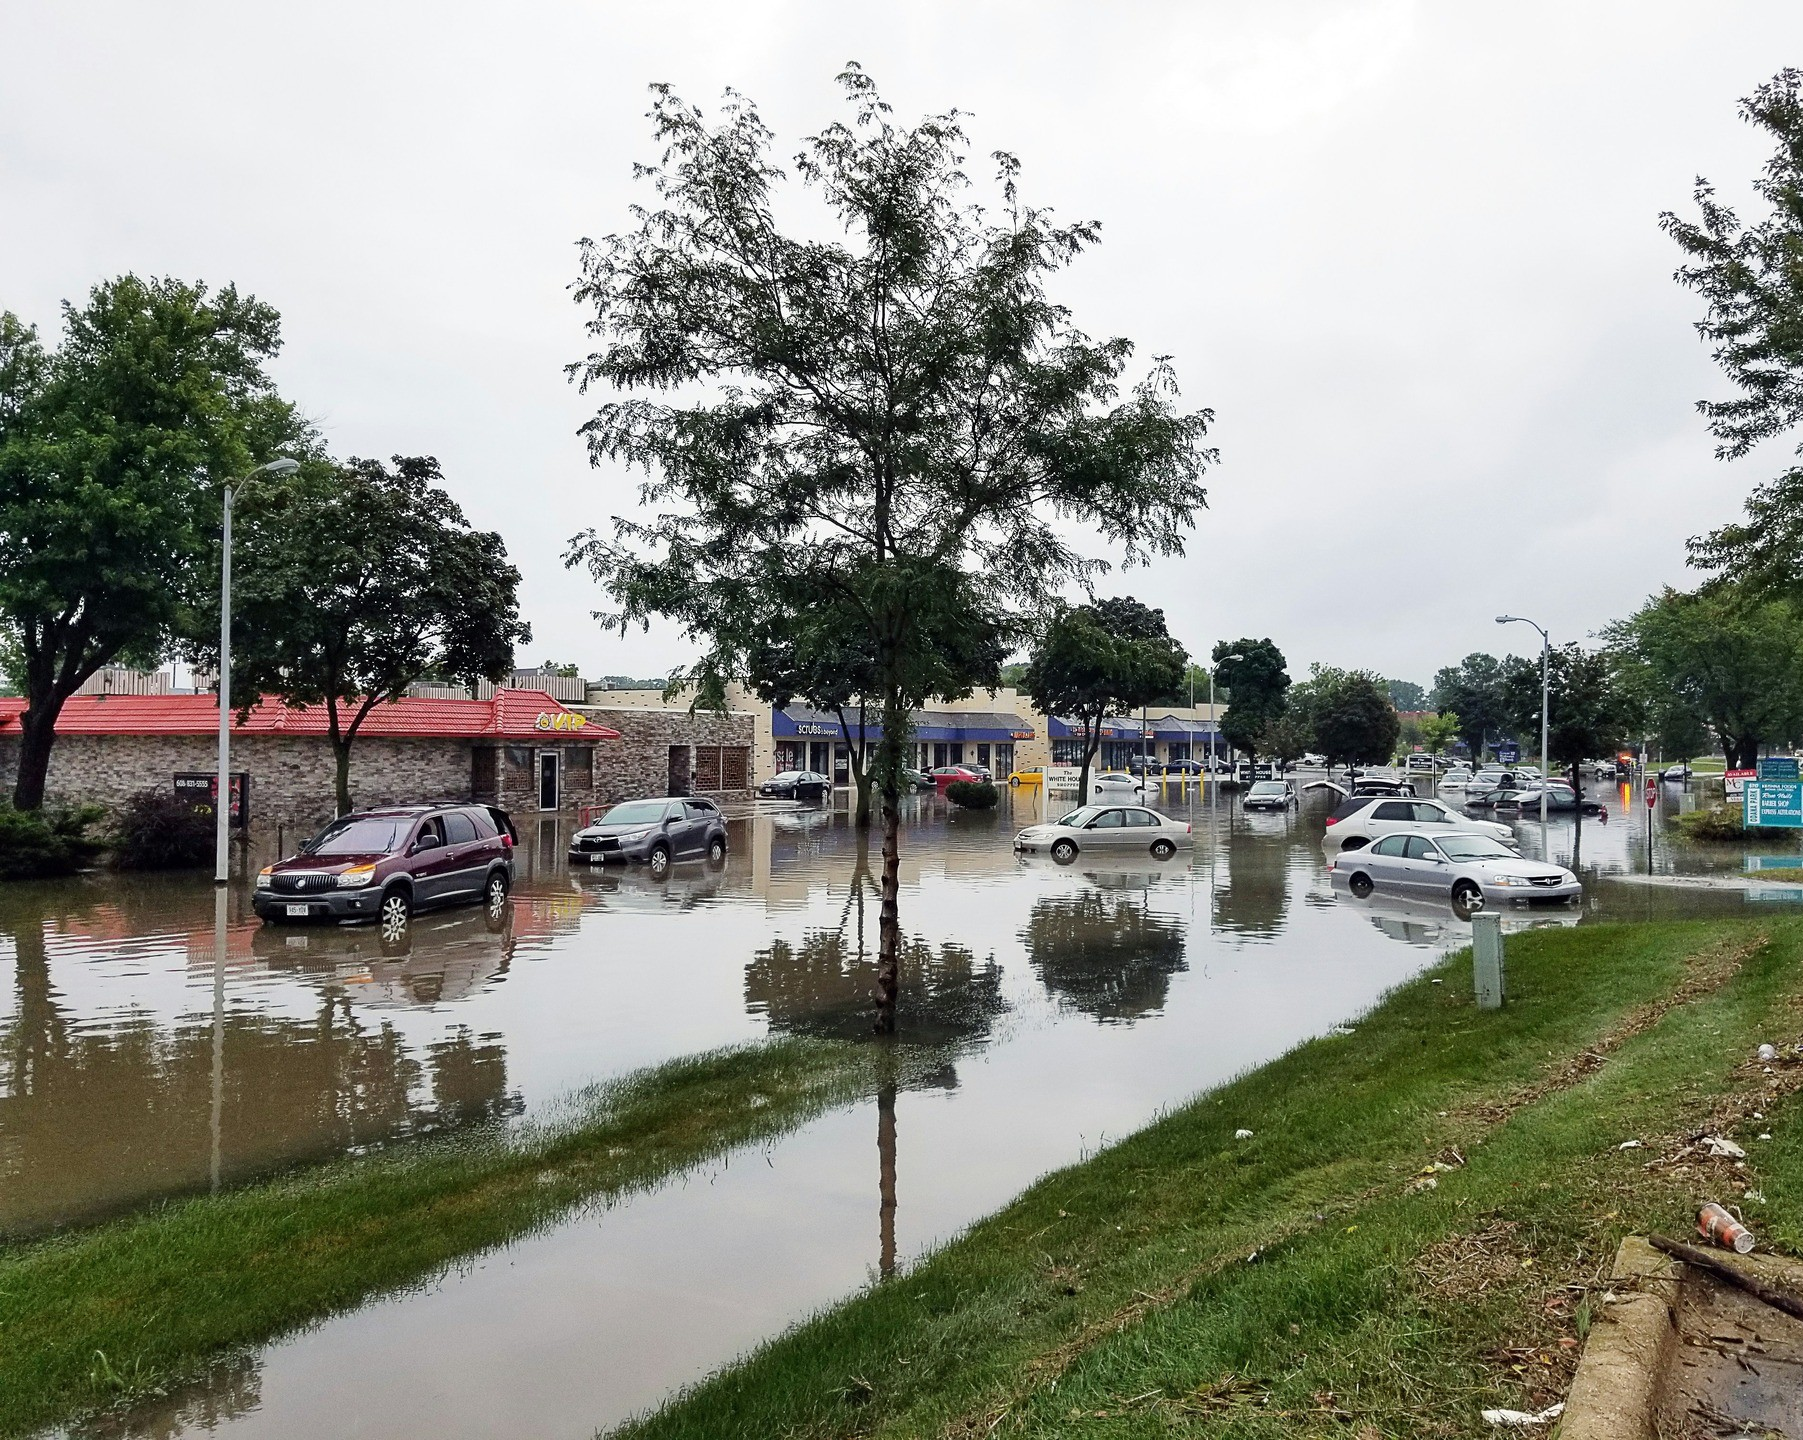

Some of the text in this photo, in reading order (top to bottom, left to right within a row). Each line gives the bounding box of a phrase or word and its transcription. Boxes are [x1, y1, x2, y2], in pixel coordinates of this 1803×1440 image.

[550, 713, 586, 730] VIP
[798, 722, 821, 734] scrubs
[1646, 788, 1656, 798] STOP
[1750, 790, 1758, 804] PARK
